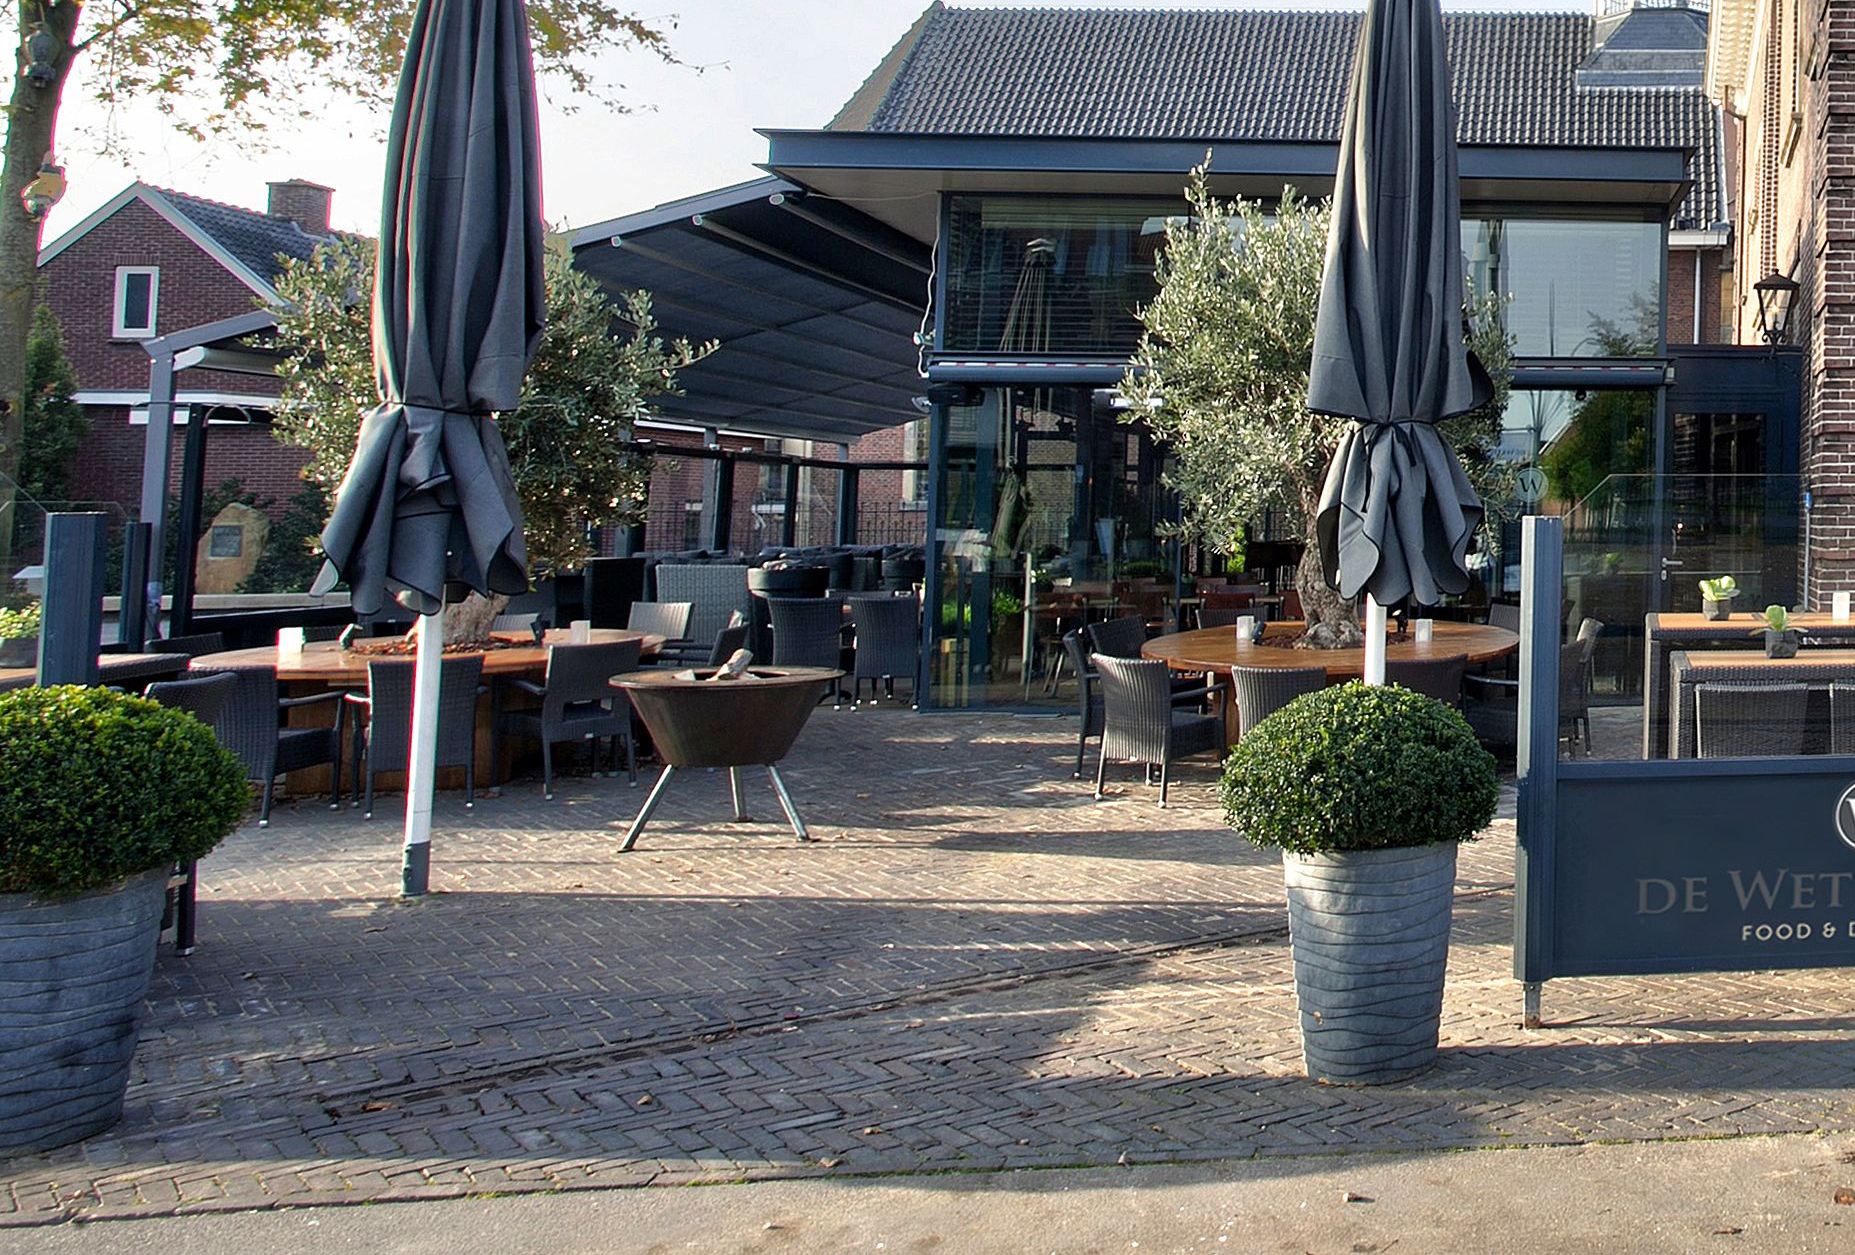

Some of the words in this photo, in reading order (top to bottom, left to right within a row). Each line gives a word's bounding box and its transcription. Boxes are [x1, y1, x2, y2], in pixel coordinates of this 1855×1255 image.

[1635, 876, 1709, 915] DE
[1741, 923, 1812, 942] FOOD
[1822, 921, 1837, 939] &
